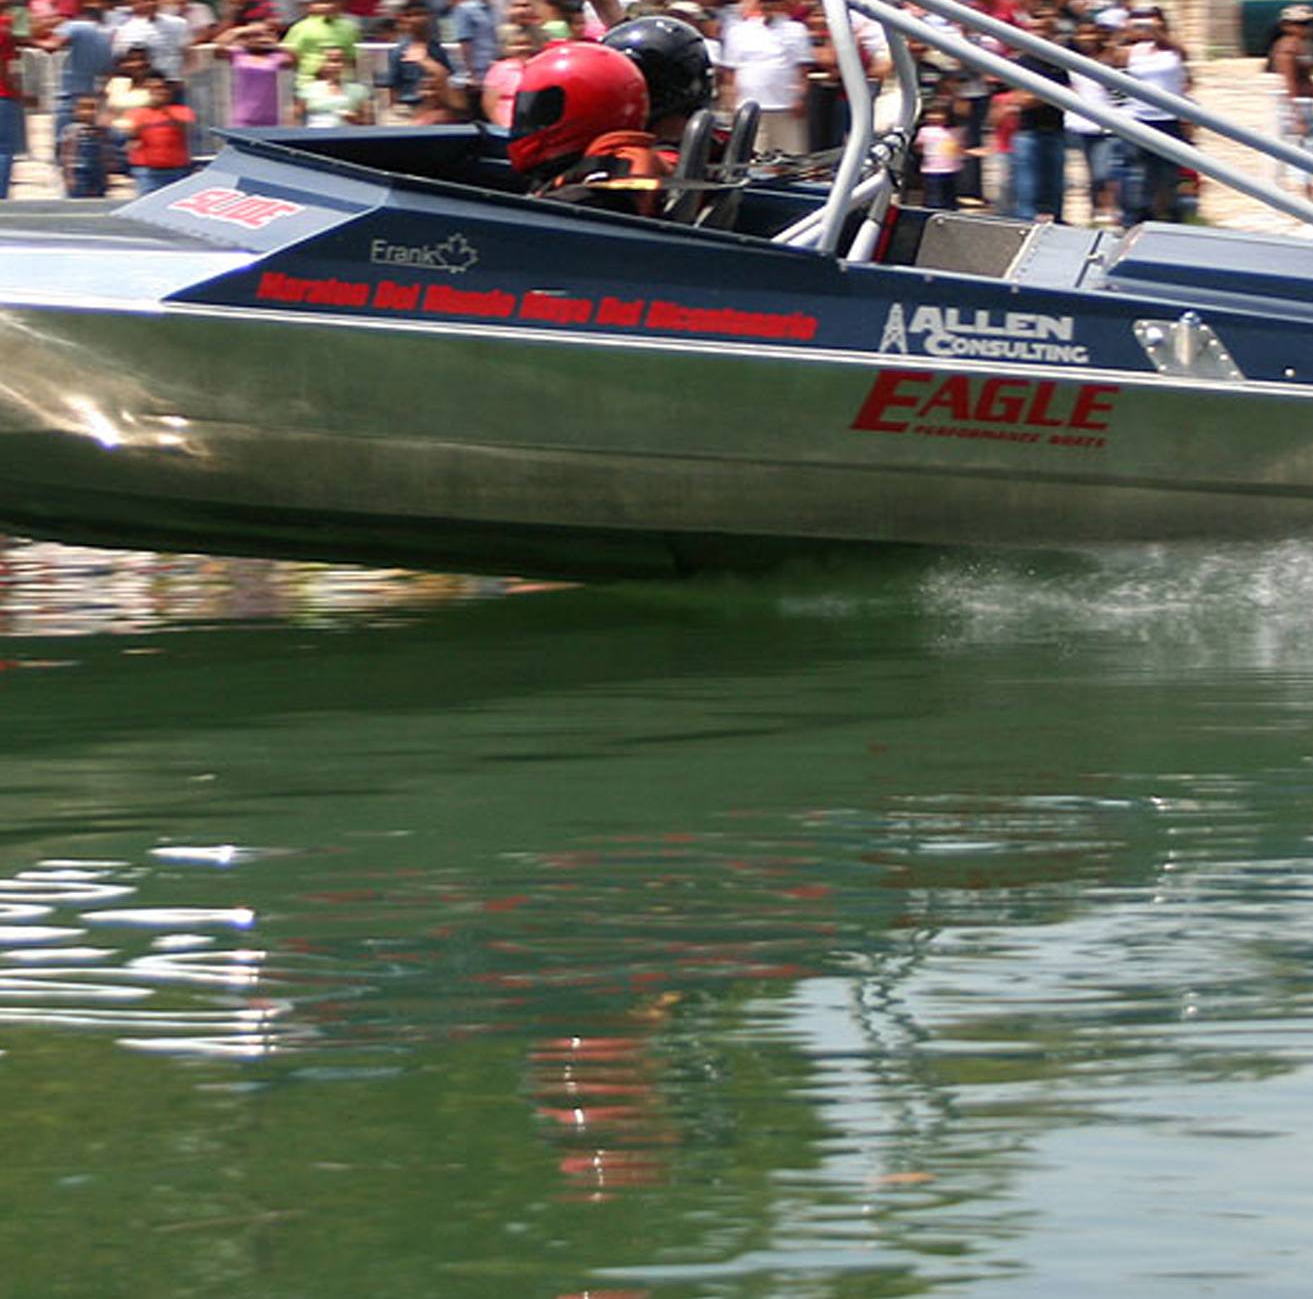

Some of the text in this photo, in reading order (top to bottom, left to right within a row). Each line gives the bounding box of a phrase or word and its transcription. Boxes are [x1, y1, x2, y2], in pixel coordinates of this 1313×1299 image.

[370, 238, 439, 265] Frank
[909, 305, 1073, 341] ALLEN
[923, 333, 1089, 364] CONSULTING
[851, 369, 1121, 433] EAGLE
